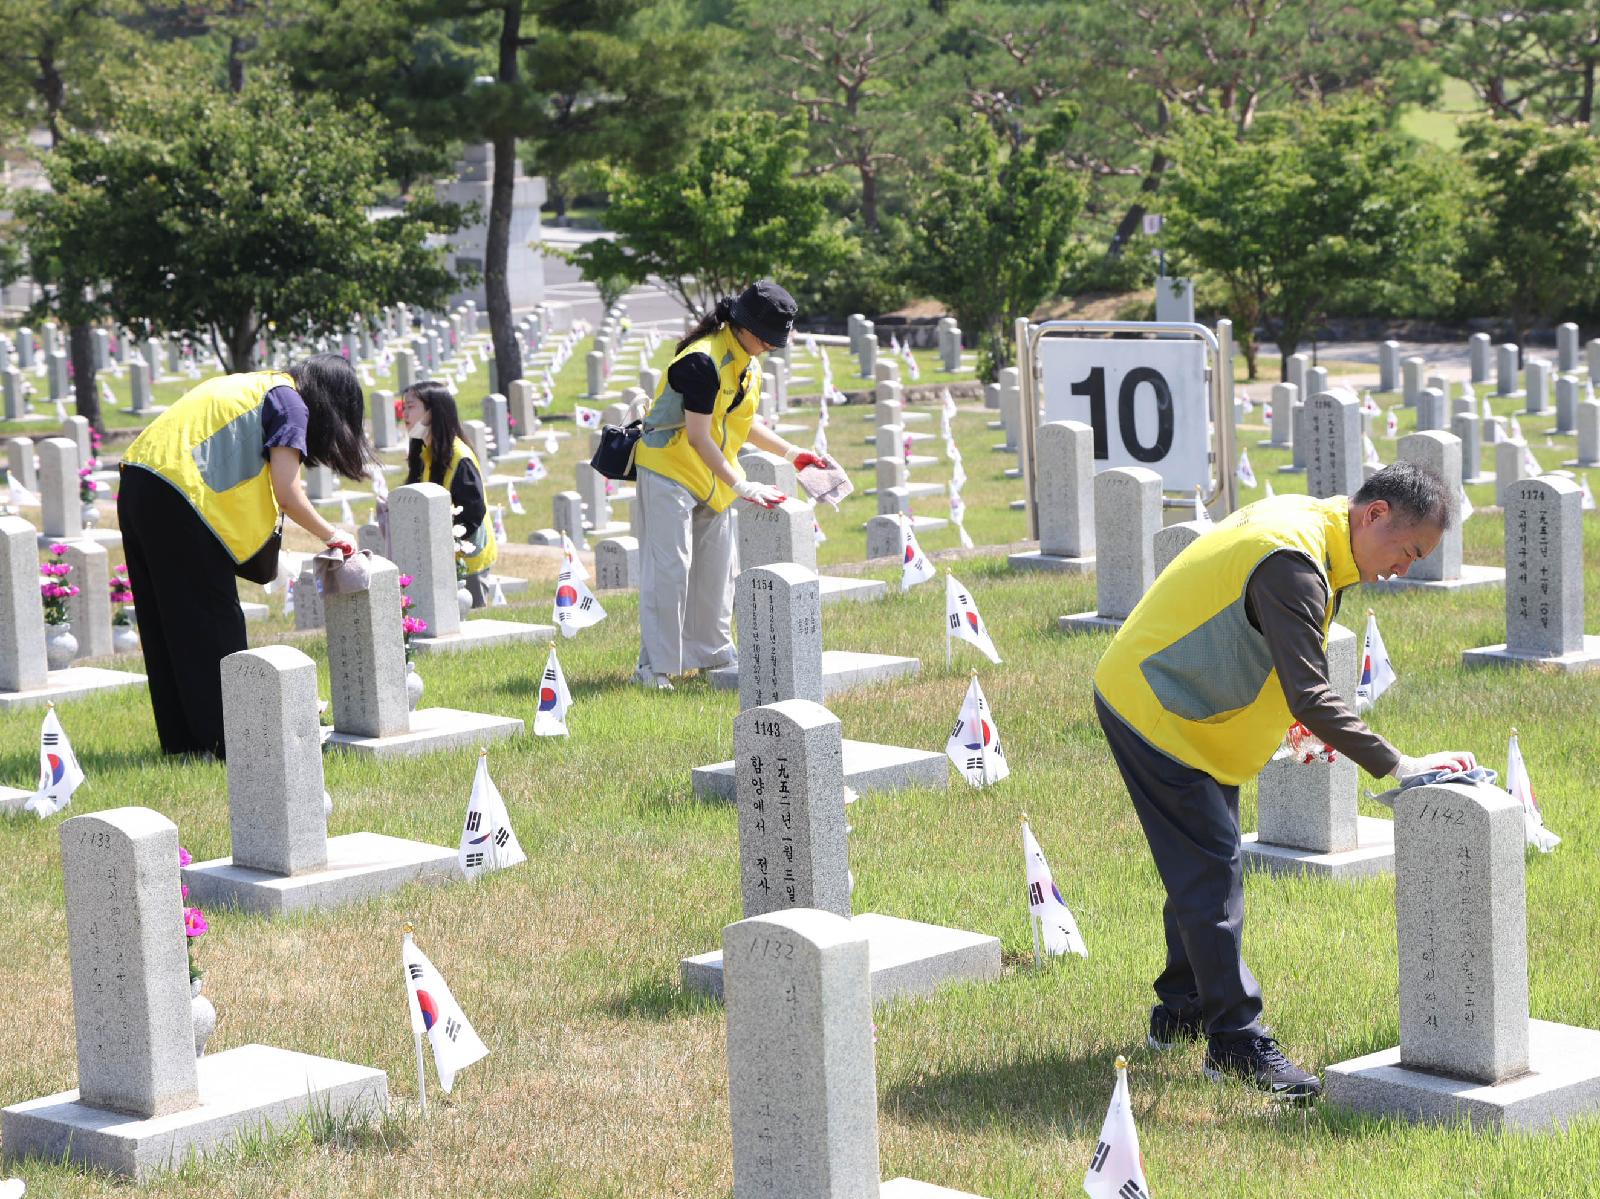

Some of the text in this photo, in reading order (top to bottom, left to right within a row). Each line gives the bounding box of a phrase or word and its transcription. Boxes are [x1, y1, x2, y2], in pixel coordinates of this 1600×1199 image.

[1070, 366, 1174, 462] 10
[1520, 490, 1545, 500] 1174
[752, 578, 773, 591] 1154
[754, 720, 781, 737] 1143
[1419, 803, 1465, 825] 1142
[751, 755, 771, 896] 함양에서 전사
[79, 832, 111, 849] 1133
[750, 938, 794, 960] 1132
